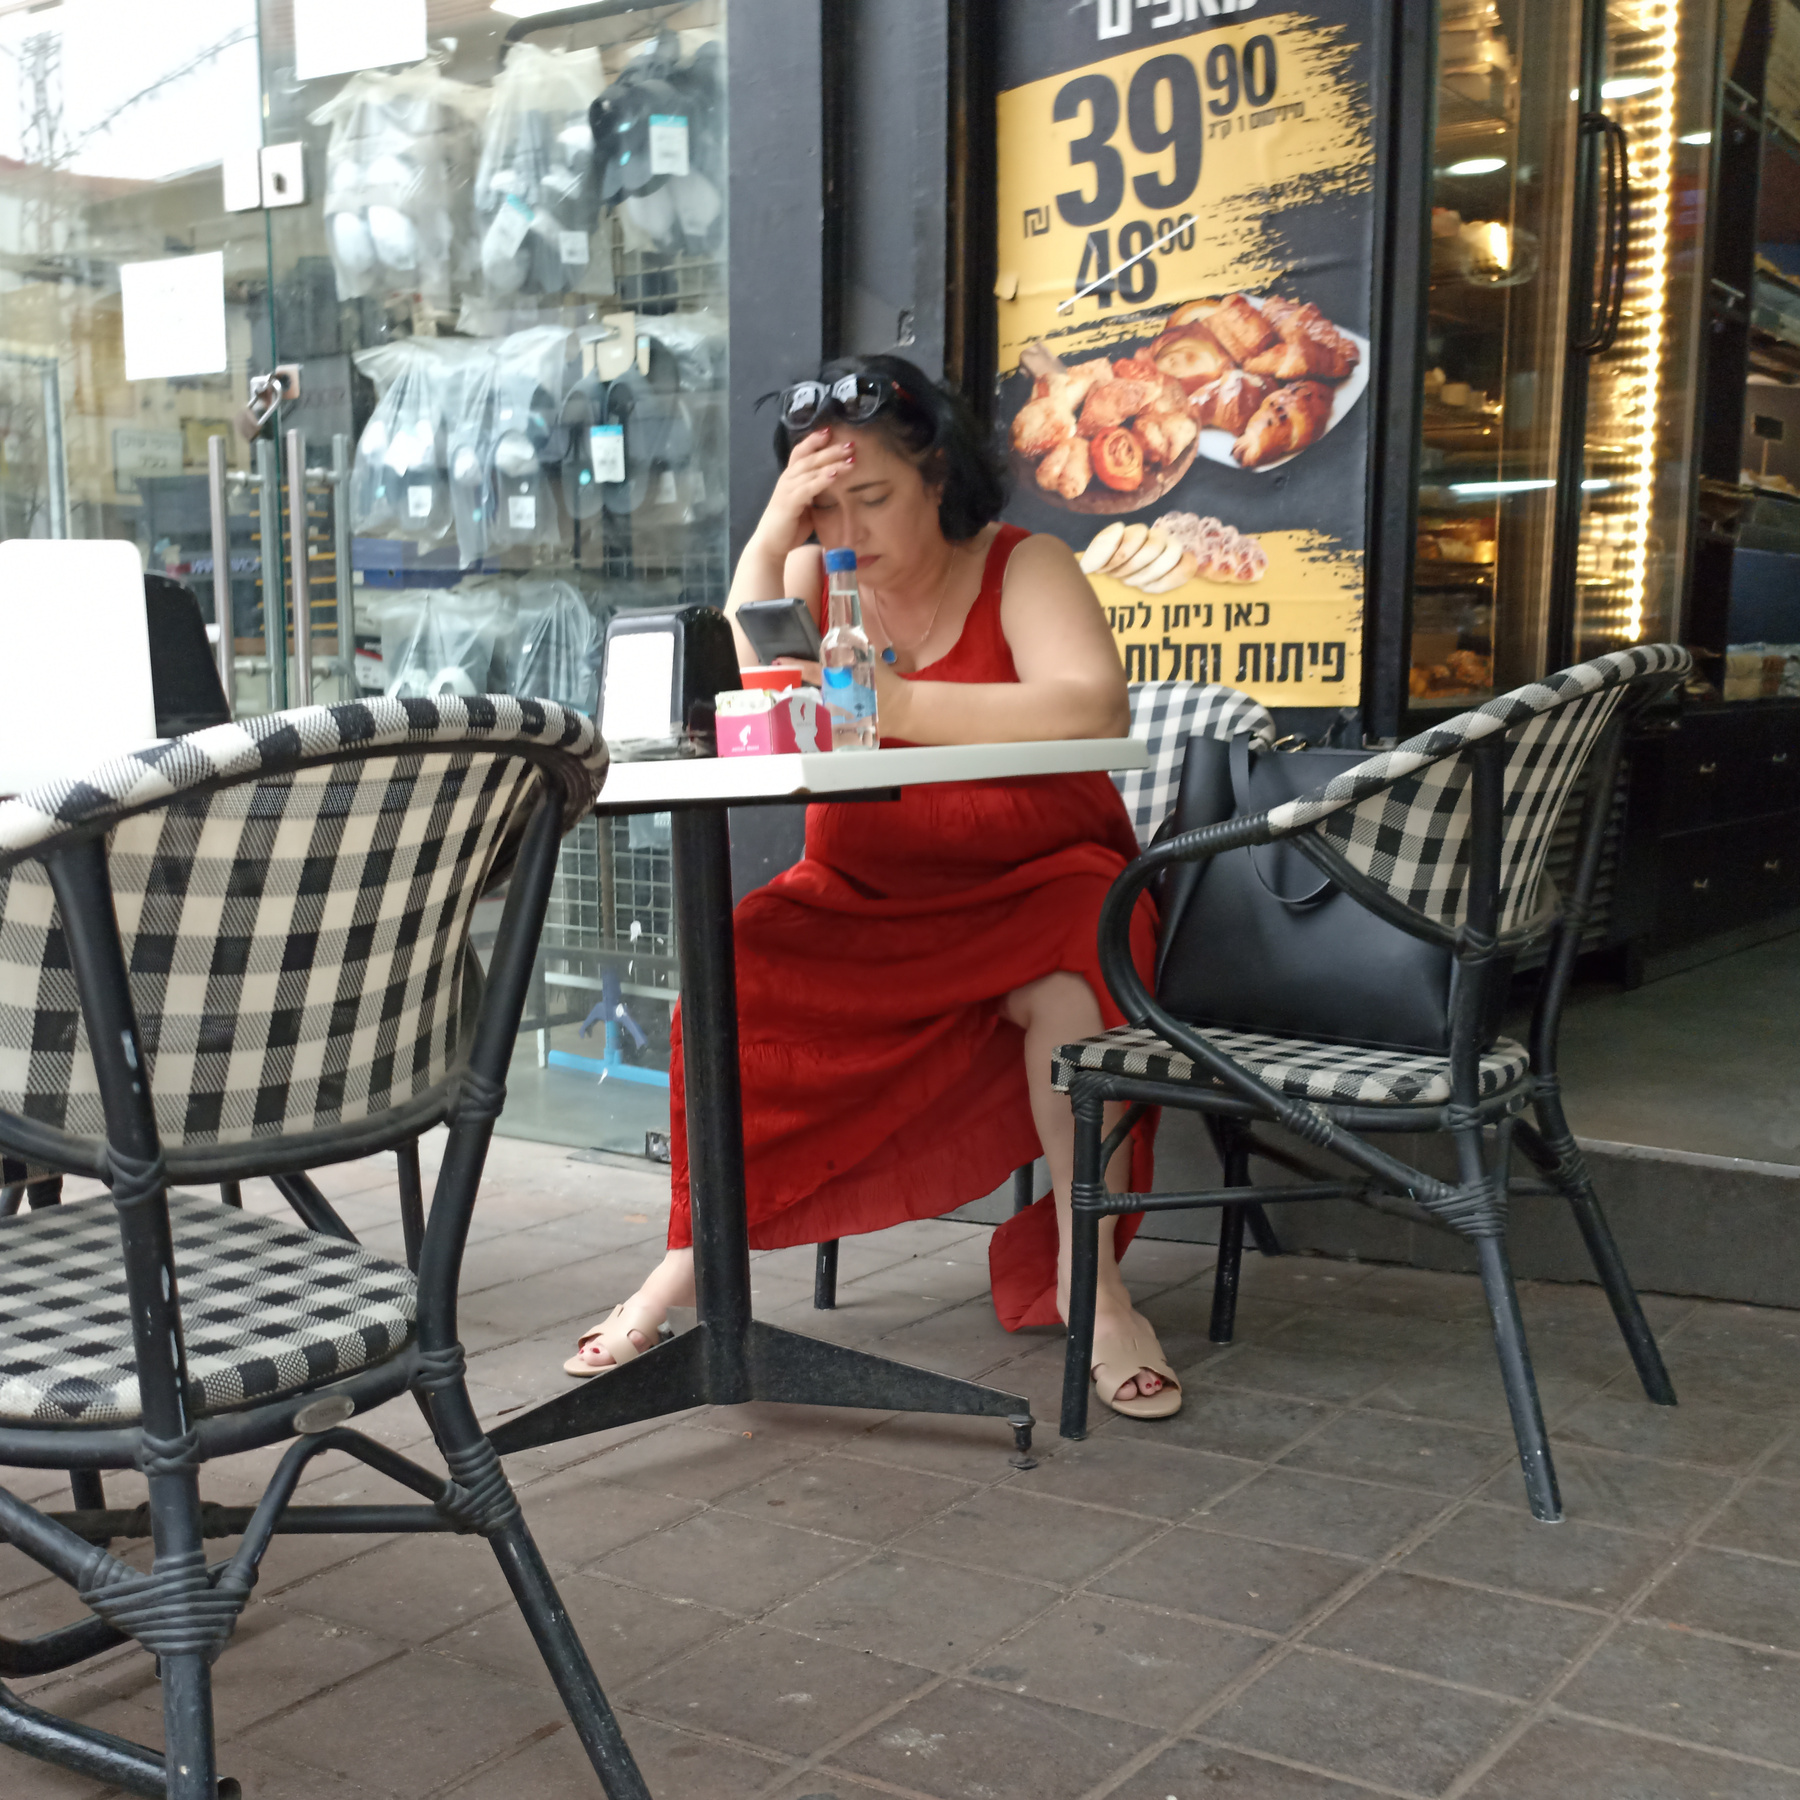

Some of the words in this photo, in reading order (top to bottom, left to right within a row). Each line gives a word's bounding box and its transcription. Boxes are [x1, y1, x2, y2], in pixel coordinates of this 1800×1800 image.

[1102, 601, 1151, 633] לקנ
[1162, 603, 1213, 633] ניתן
[1224, 602, 1270, 632] כאן
[1126, 636, 1222, 682] וחלות
[1236, 641, 1346, 683] פיתות
